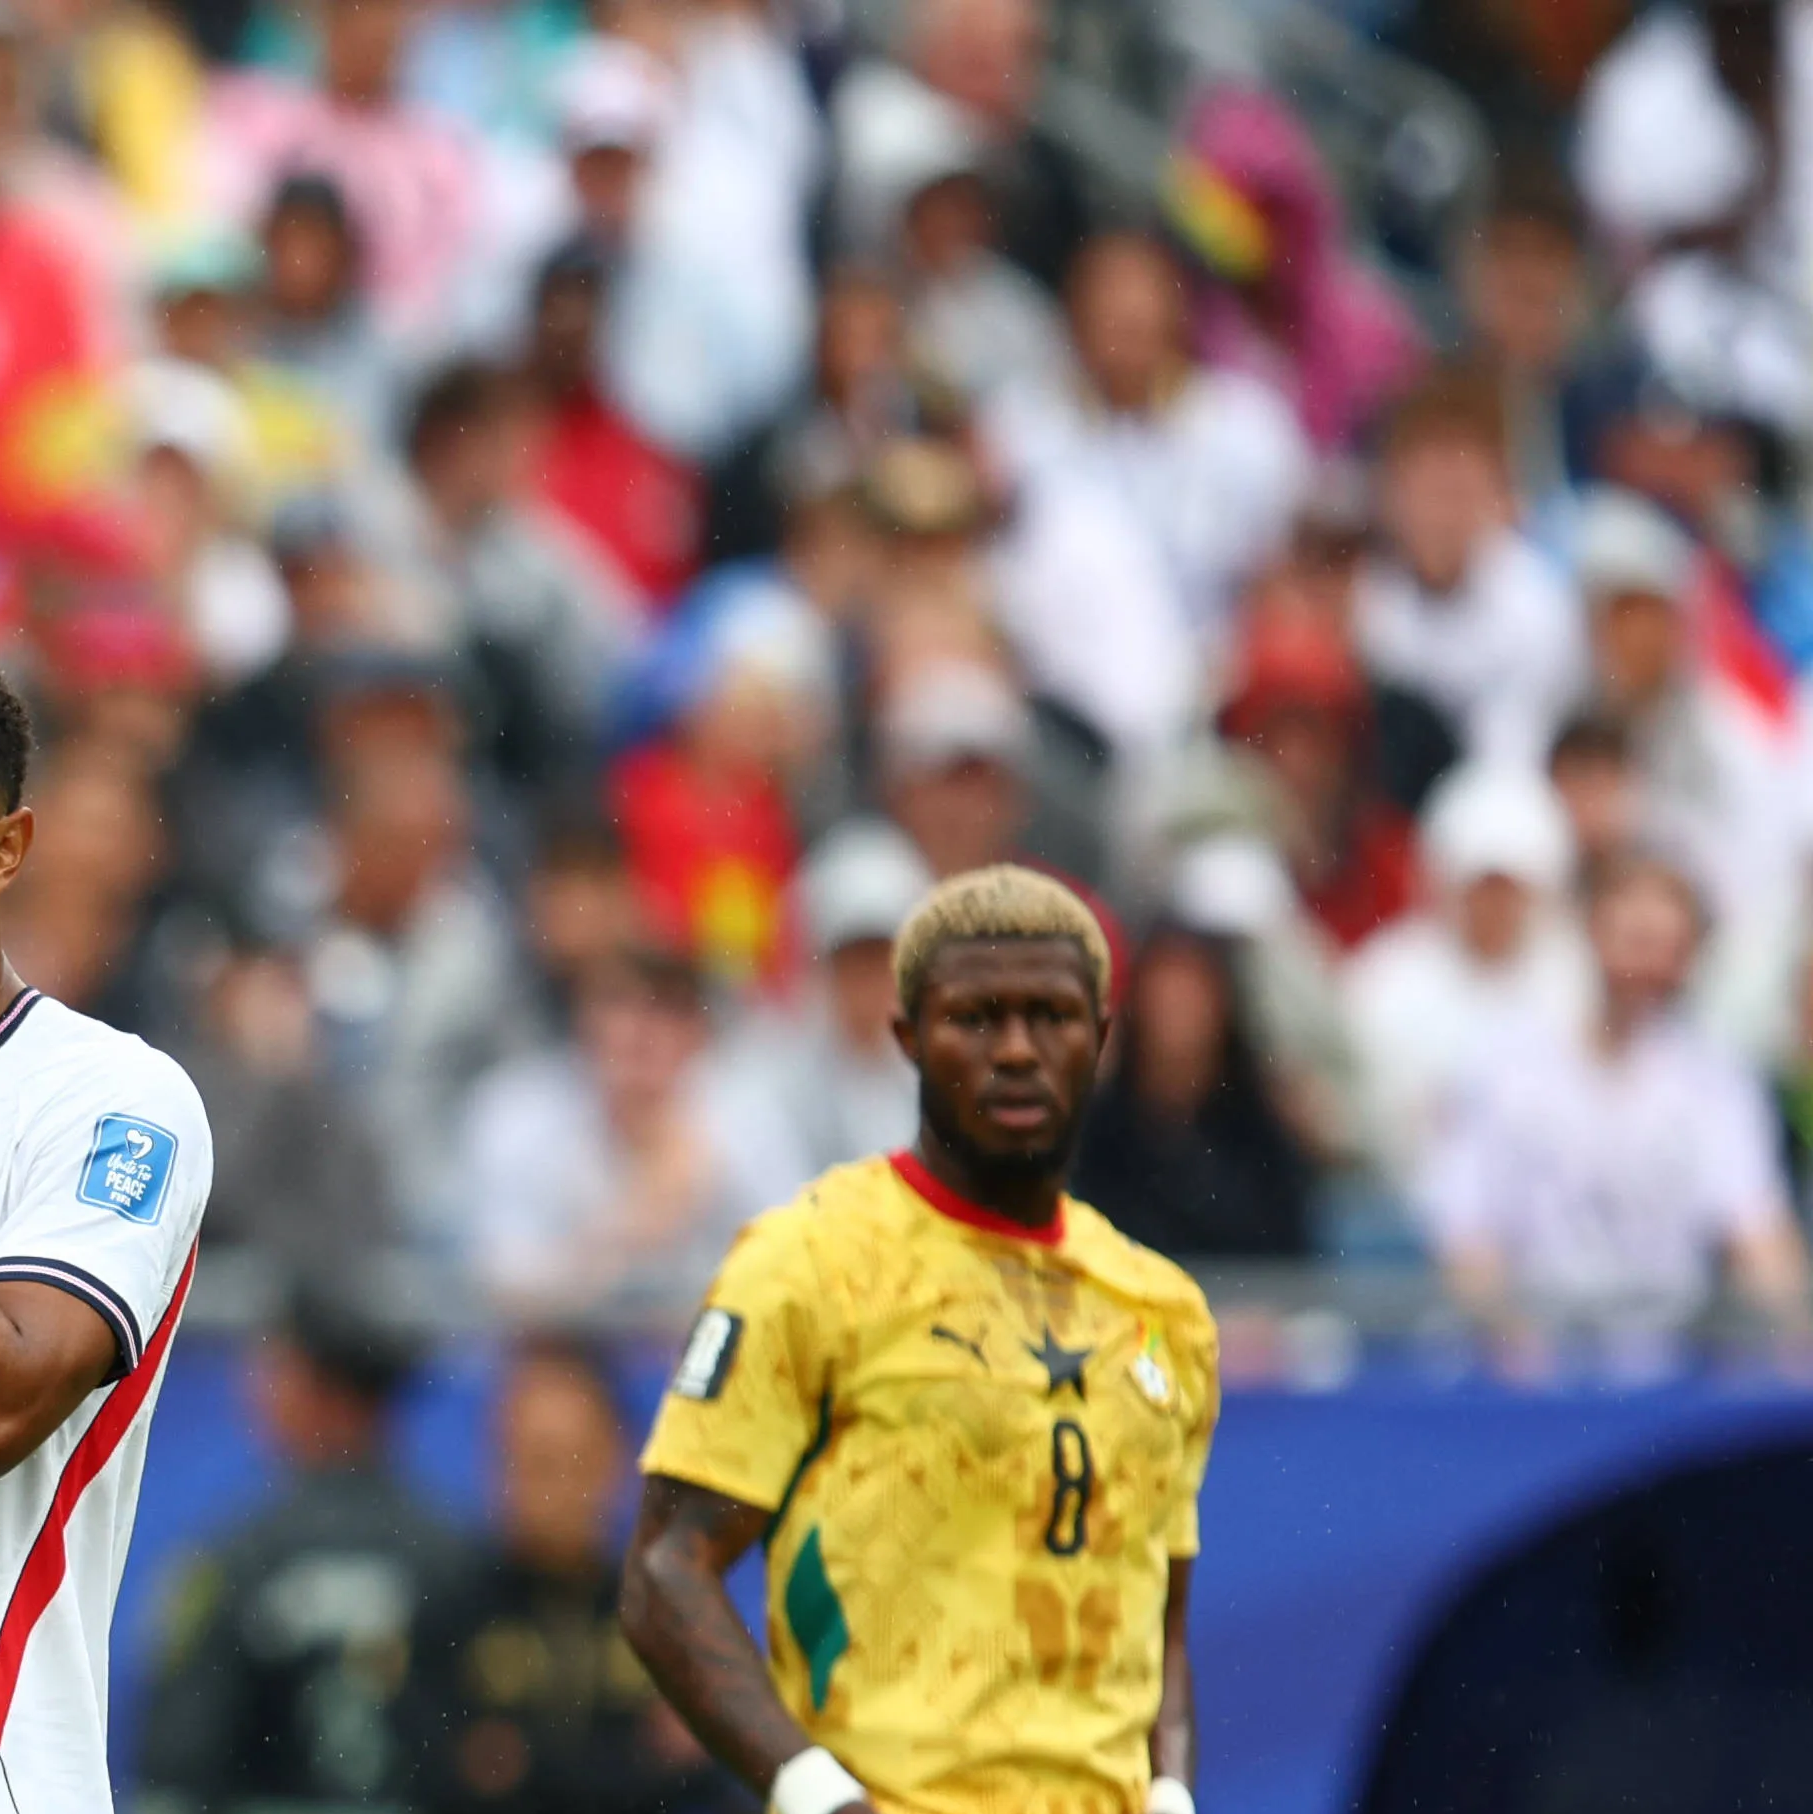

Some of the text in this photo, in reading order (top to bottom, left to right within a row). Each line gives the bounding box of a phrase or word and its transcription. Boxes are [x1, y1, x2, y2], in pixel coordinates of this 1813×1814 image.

[106, 1153, 138, 1175] Unite
[104, 1170, 147, 1201] PEACE
[1045, 1418, 1091, 1557] 8
